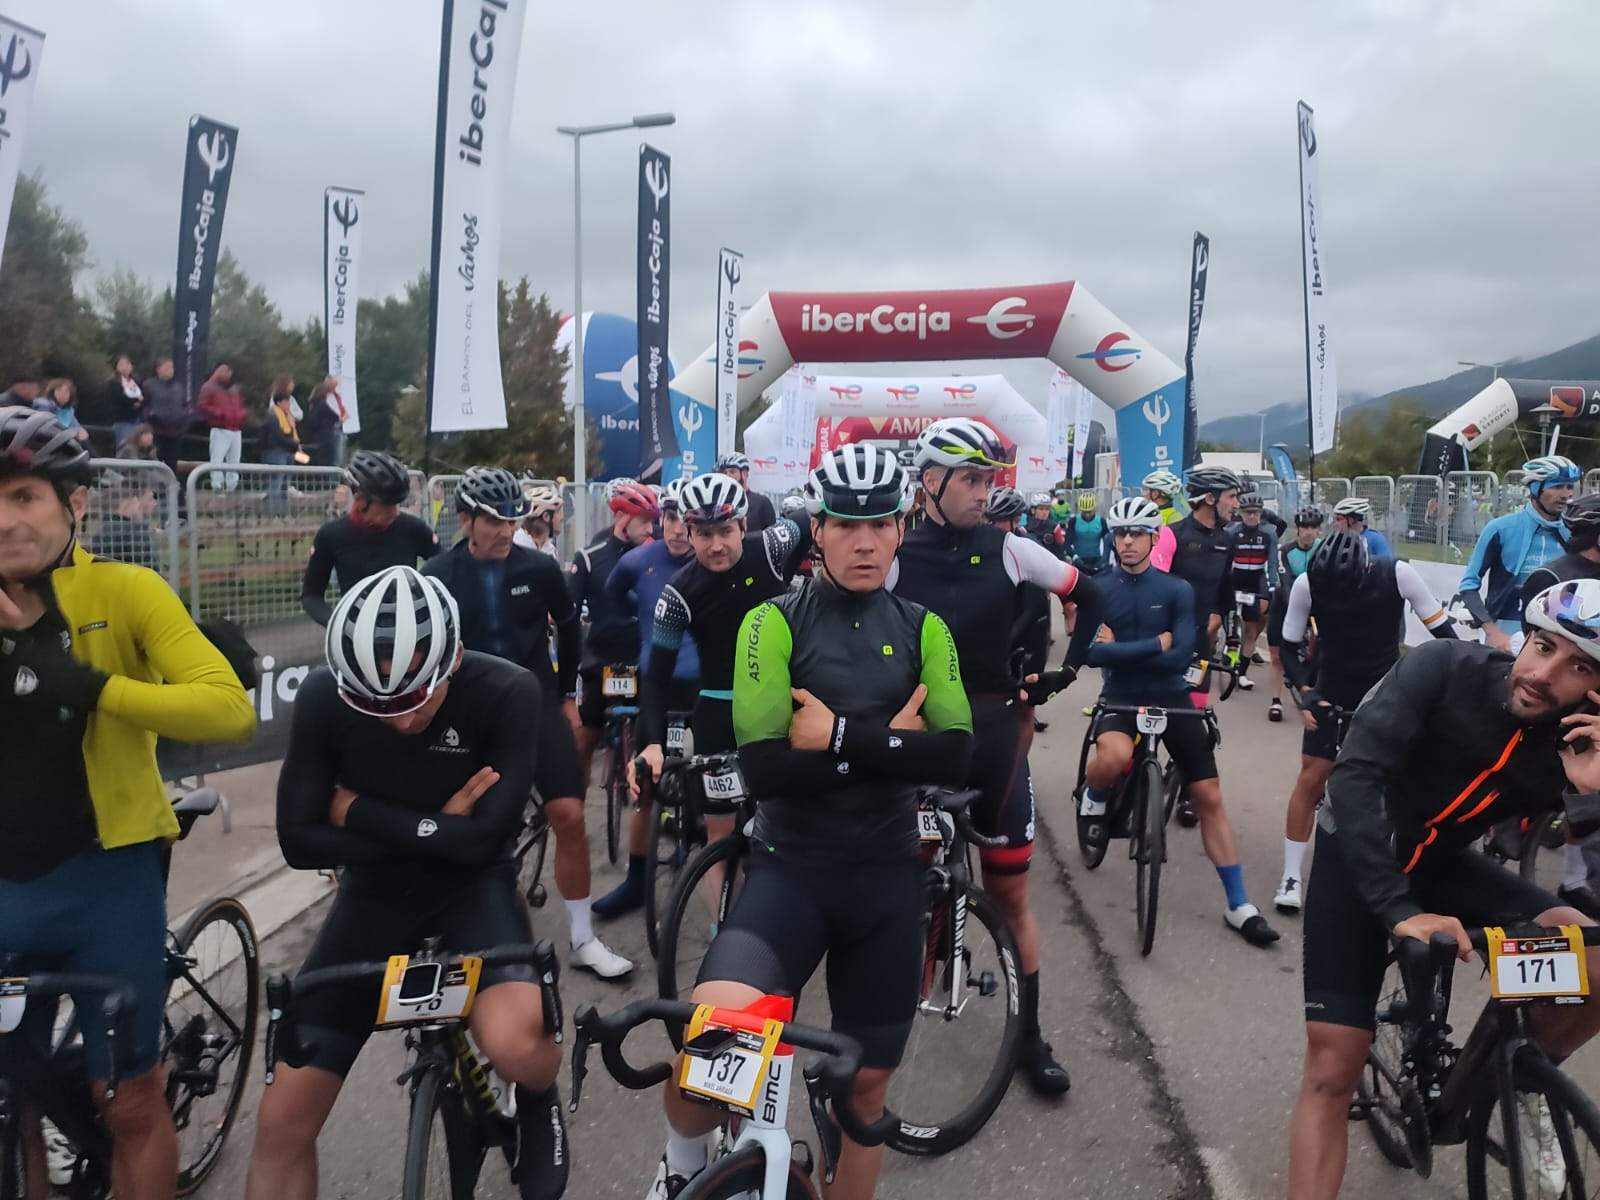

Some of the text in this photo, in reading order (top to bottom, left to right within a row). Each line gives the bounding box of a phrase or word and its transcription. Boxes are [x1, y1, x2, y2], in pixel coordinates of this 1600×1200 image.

[188, 189, 215, 290] iberCaja
[648, 218, 664, 323] iberCaja
[334, 246, 352, 324] iberCaja
[724, 301, 737, 375] iberCaja
[801, 304, 951, 340] iberCaja
[461, 336, 471, 392] BANCO
[612, 680, 628, 689] 114
[1516, 958, 1556, 984] 171
[762, 1060, 781, 1124] BMC
